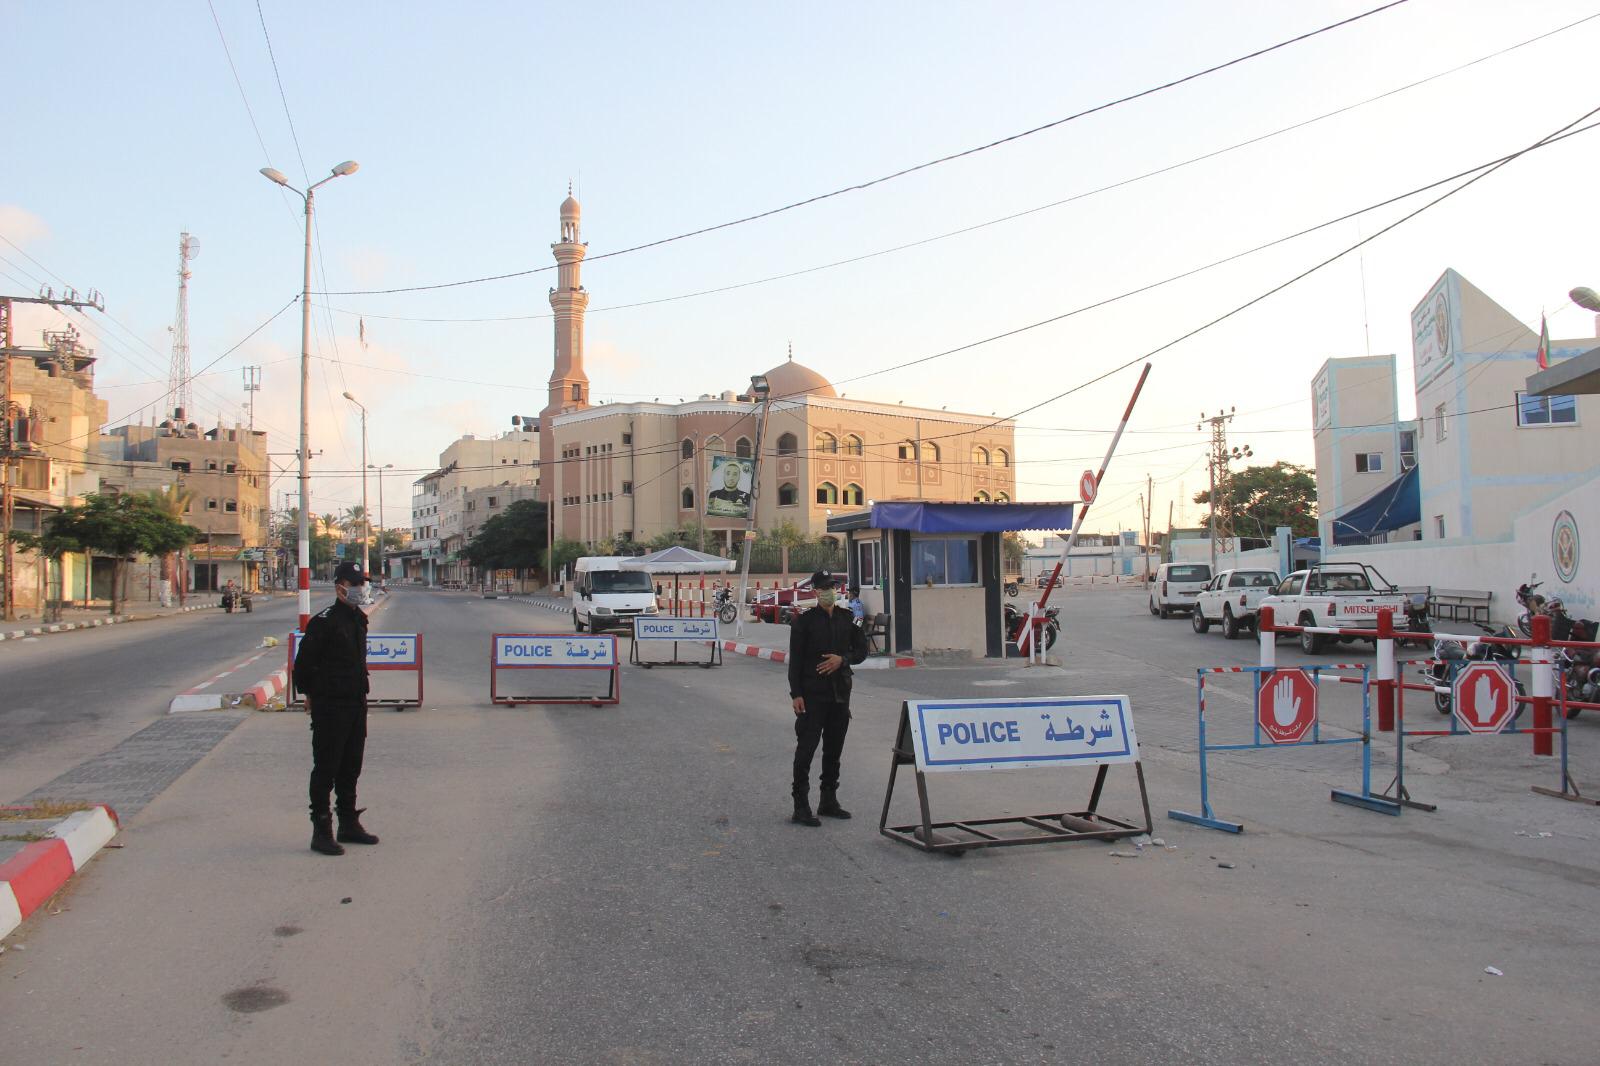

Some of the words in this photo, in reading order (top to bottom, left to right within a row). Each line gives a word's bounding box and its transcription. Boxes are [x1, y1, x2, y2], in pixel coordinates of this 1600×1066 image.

[643, 625, 675, 633] POLICE
[682, 622, 711, 635] شرطة
[504, 644, 553, 658] POLICE
[566, 641, 608, 660] شرطة
[938, 720, 1021, 745] POLICE
[1040, 708, 1113, 746] شرطة
